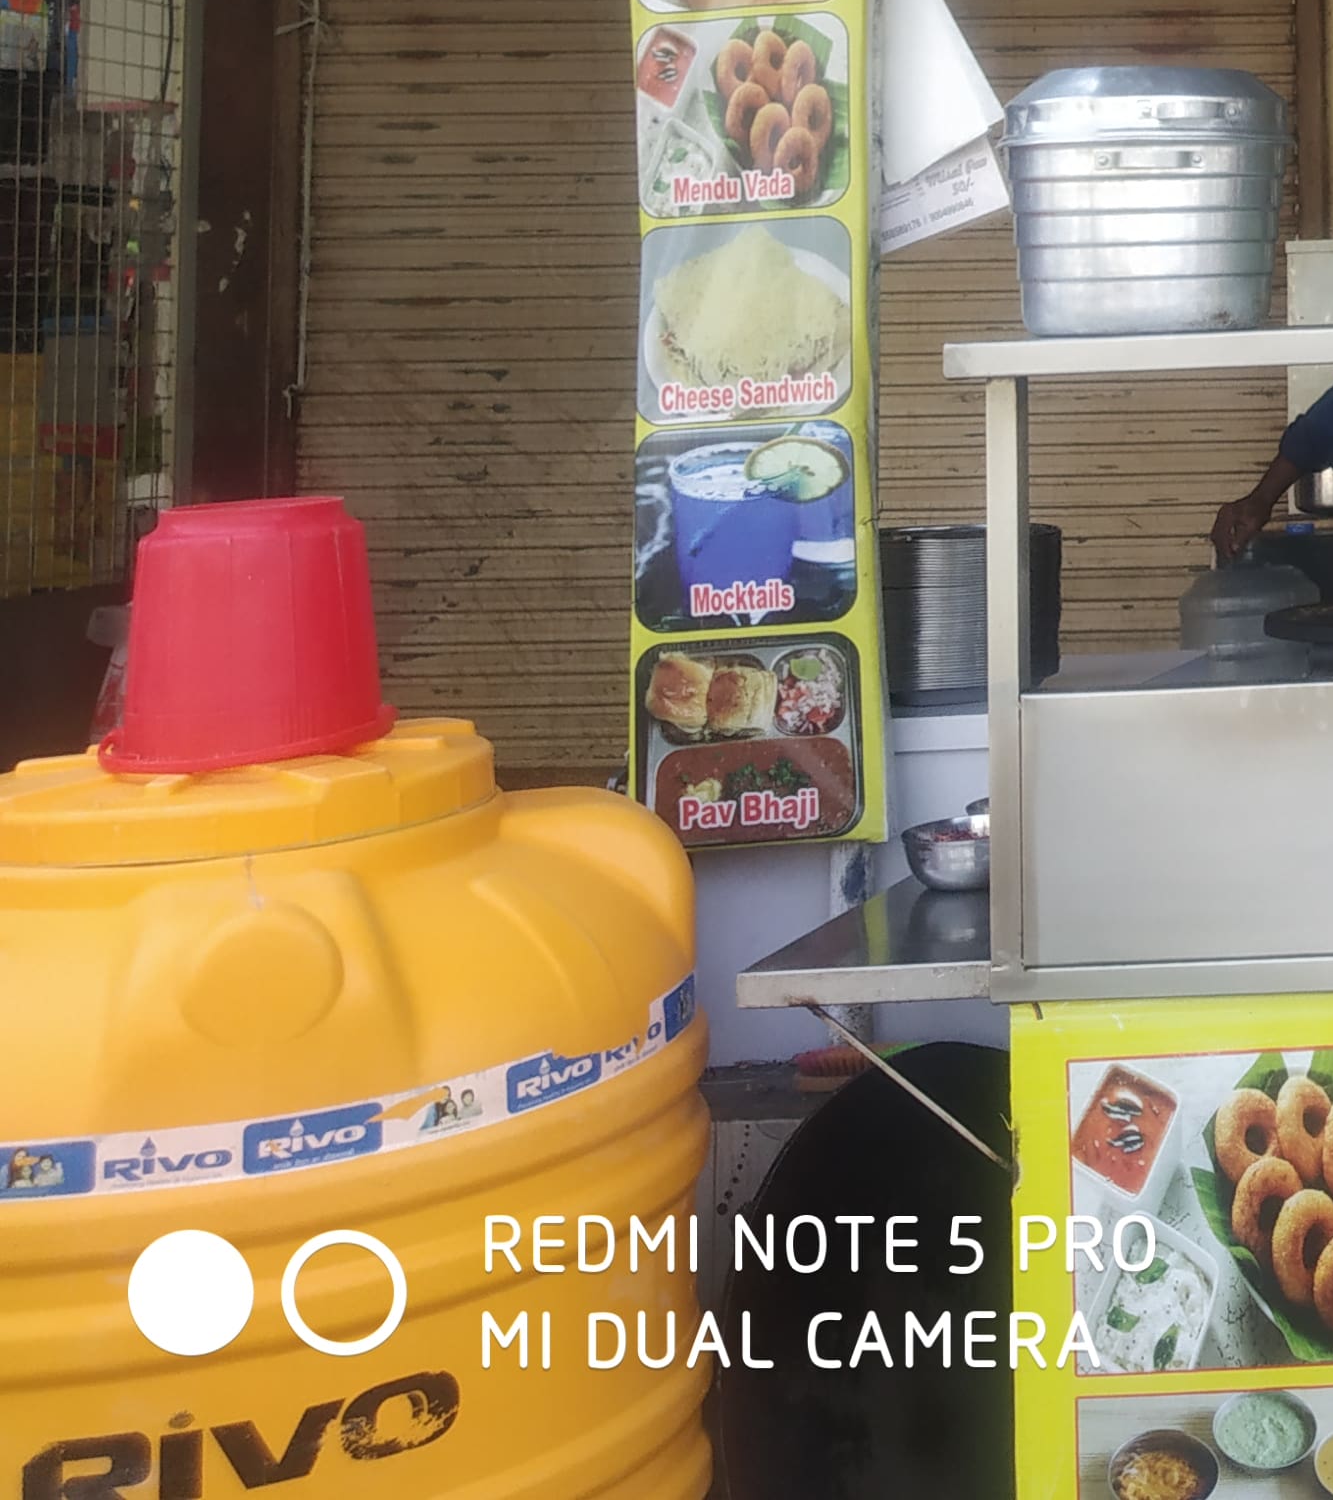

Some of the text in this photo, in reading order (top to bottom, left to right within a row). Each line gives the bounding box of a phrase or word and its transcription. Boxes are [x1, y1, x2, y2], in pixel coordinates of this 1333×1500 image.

[673, 169, 793, 205] Mendu Vada
[660, 372, 836, 412] Cheese Sandwich
[690, 579, 795, 617] Mocktails
[680, 788, 819, 830] Pav Bhaji
